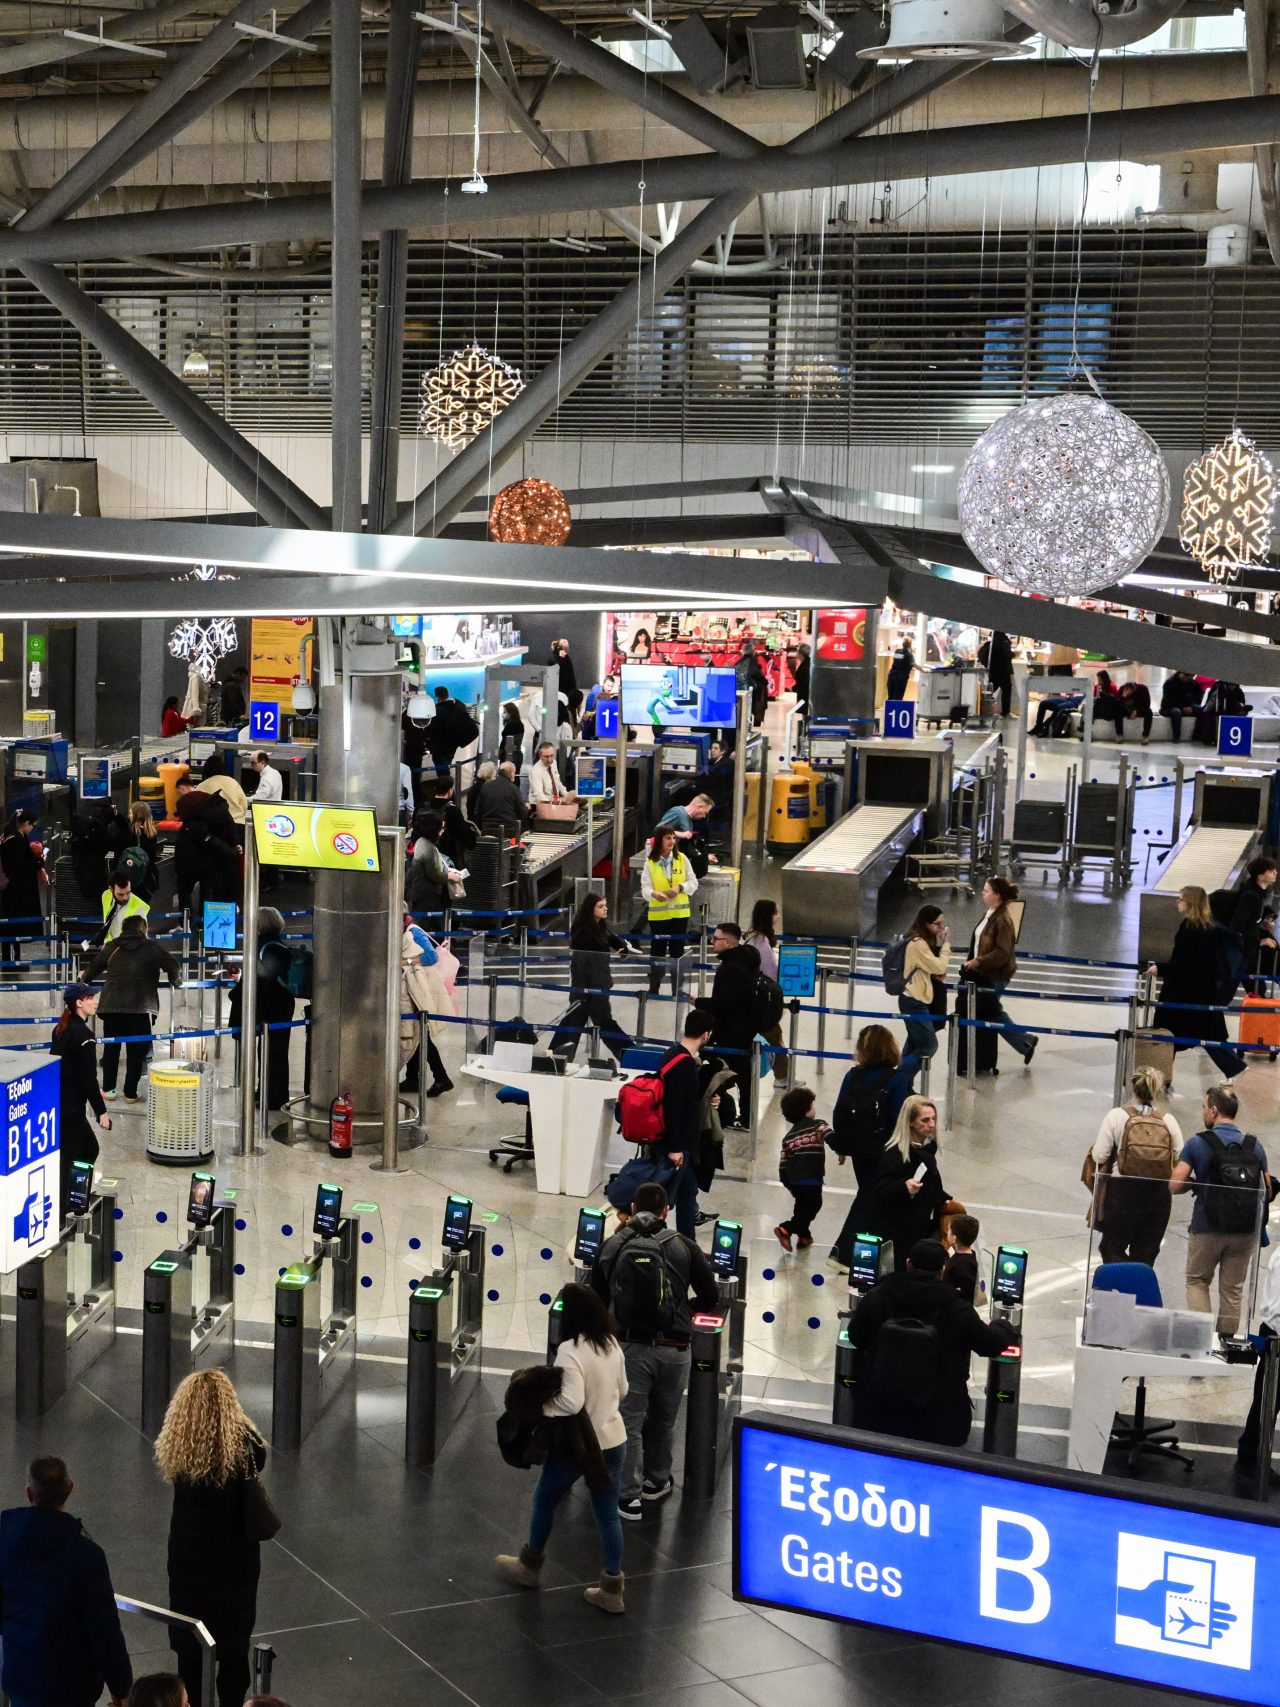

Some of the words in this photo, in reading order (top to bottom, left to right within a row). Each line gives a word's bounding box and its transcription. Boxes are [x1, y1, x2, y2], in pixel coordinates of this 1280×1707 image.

[253, 711, 275, 731] 12
[888, 709, 911, 729] 10
[1229, 726, 1242, 746] 9
[7, 1078, 33, 1101] Έξοδοι
[8, 1102, 28, 1122] Gates
[8, 1125, 20, 1169] B
[24, 1107, 56, 1159] 1-31
[764, 1462, 930, 1537] Έξοδοι
[780, 1533, 903, 1598] Gates
[979, 1504, 1053, 1625] B
